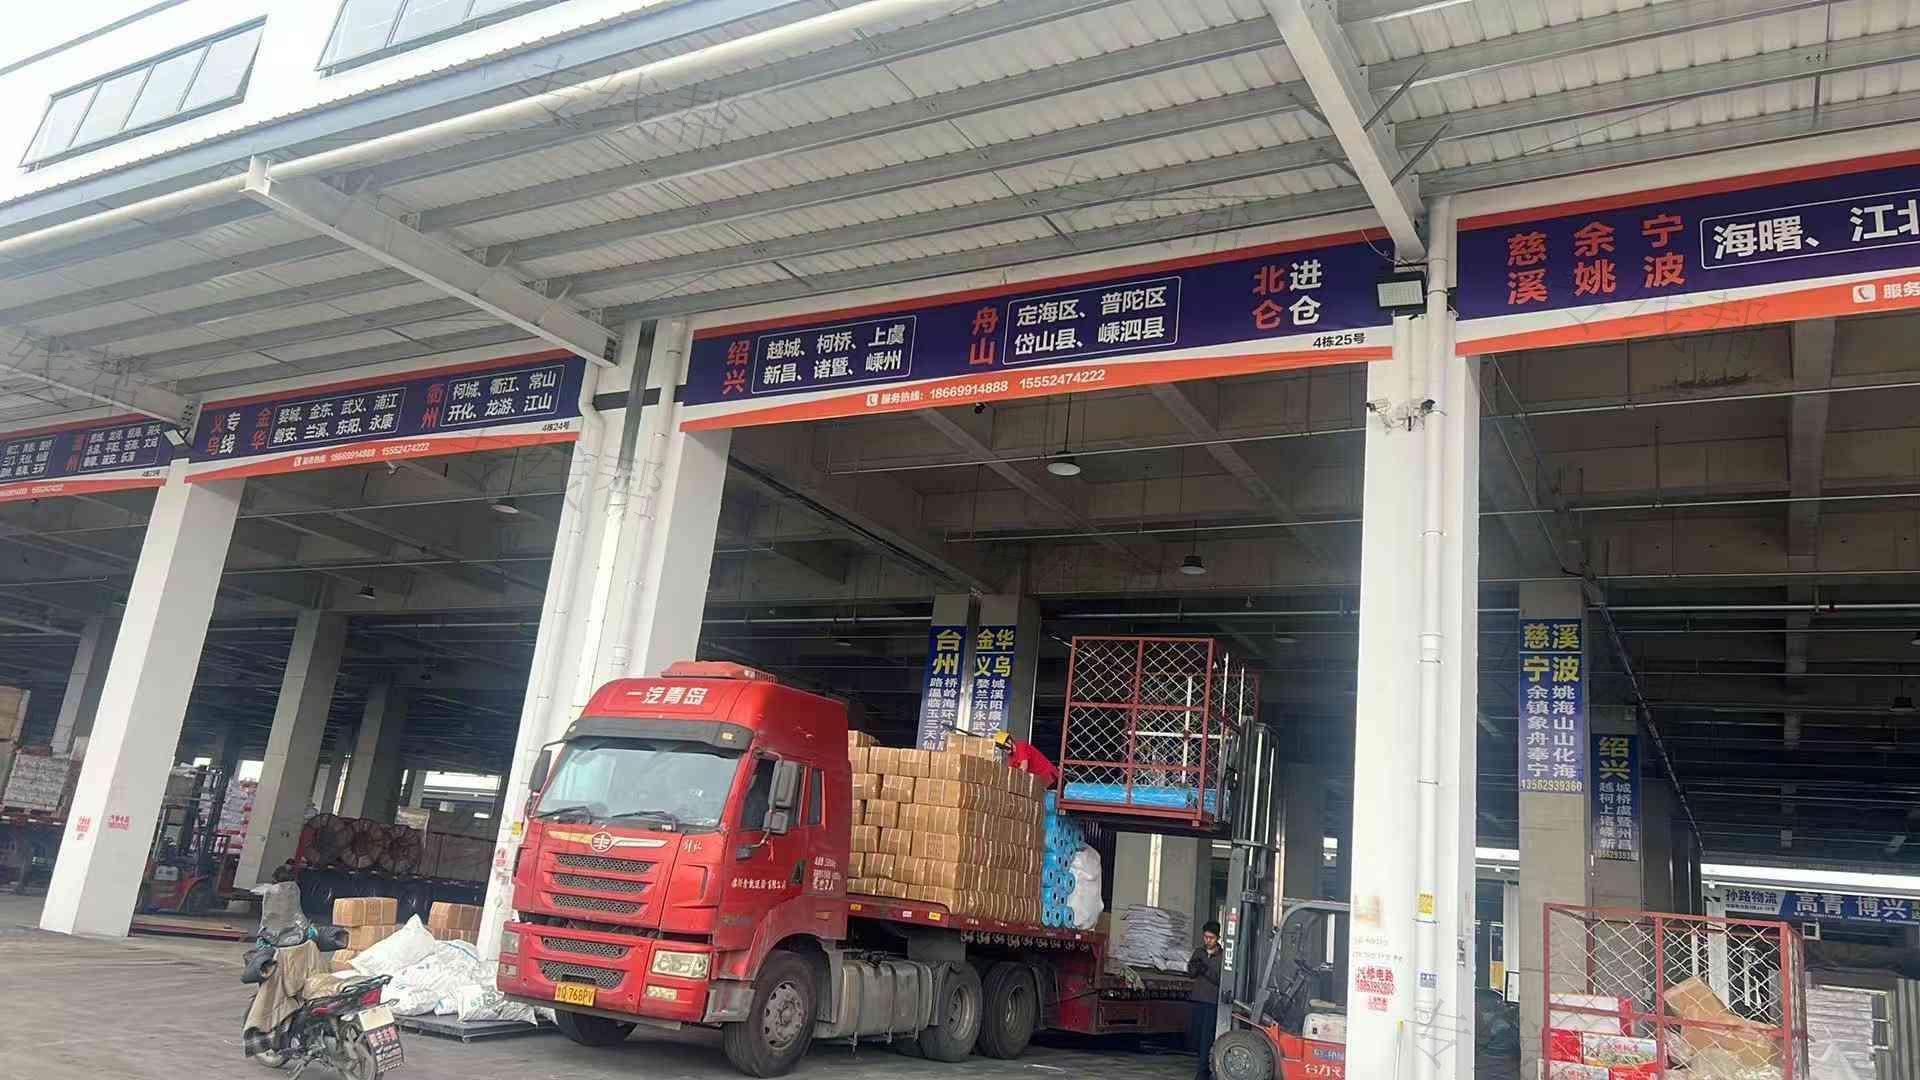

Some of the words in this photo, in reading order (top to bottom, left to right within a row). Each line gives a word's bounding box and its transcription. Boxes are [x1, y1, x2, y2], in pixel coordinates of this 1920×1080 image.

[1506, 231, 1548, 306] 慈溪
[1573, 221, 1618, 297] 余姚
[1641, 213, 1686, 289] 宁波
[1016, 286, 1167, 328] 定海区、普陀区
[1252, 264, 1286, 330] 北仑
[1288, 259, 1323, 326] 进仓
[766, 325, 906, 361] 越城、柯桥、上虞
[968, 306, 998, 366] 舟山
[1014, 317, 1165, 356] 岱山县、嵊泗县
[1312, 332, 1366, 348] 4栋25号
[721, 340, 750, 395] 绍兴
[763, 350, 902, 385] 新昌、诸暨、嵊州
[929, 380, 1009, 401] 18669914888
[1018, 369, 1106, 390] 15552474222
[447, 393, 552, 422] 开化、龙游、江山
[219, 412, 240, 454] 专线
[250, 409, 272, 450] 金华
[932, 629, 962, 675] 台州
[976, 629, 1014, 651] 金华
[1523, 623, 1580, 649] 慈溪
[973, 655, 1012, 677] 义乌
[1523, 655, 1580, 682] 宁波
[626, 686, 709, 706] 一汽青岛
[1526, 684, 1576, 699] 余姚
[1526, 731, 1575, 746] 舟山
[1527, 716, 1575, 730] 象山
[1598, 736, 1631, 780] 绍兴
[1794, 892, 1844, 915] 高青
[1855, 897, 1907, 919] 博兴
